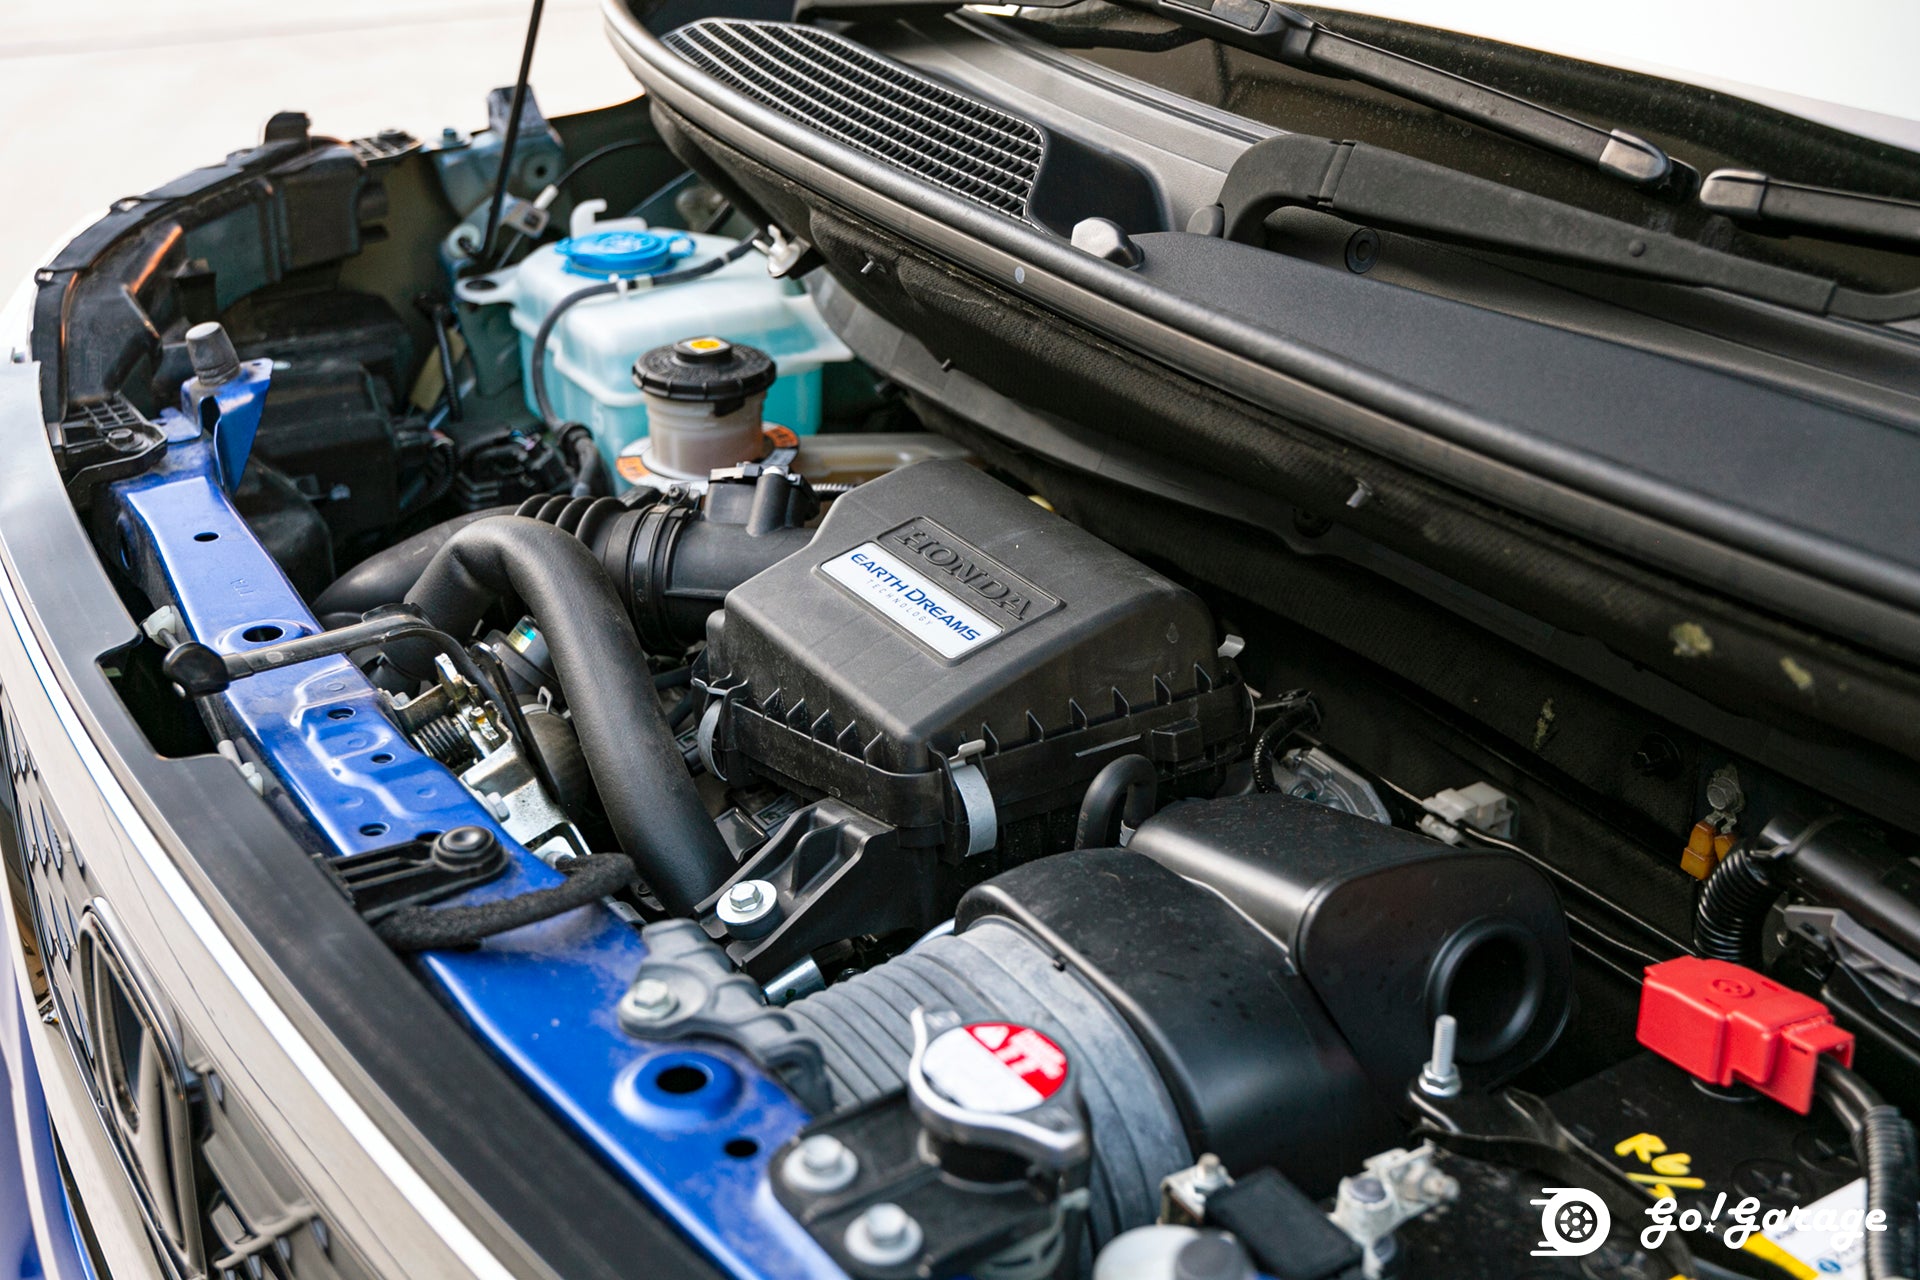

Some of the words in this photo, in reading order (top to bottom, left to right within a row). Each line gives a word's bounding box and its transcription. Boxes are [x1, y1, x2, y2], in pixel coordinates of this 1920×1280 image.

[850, 553, 906, 596] EARTH
[904, 588, 981, 641] DREAMS
[866, 579, 934, 626] TECHNOLOGY
[893, 526, 1033, 620] HONDA
